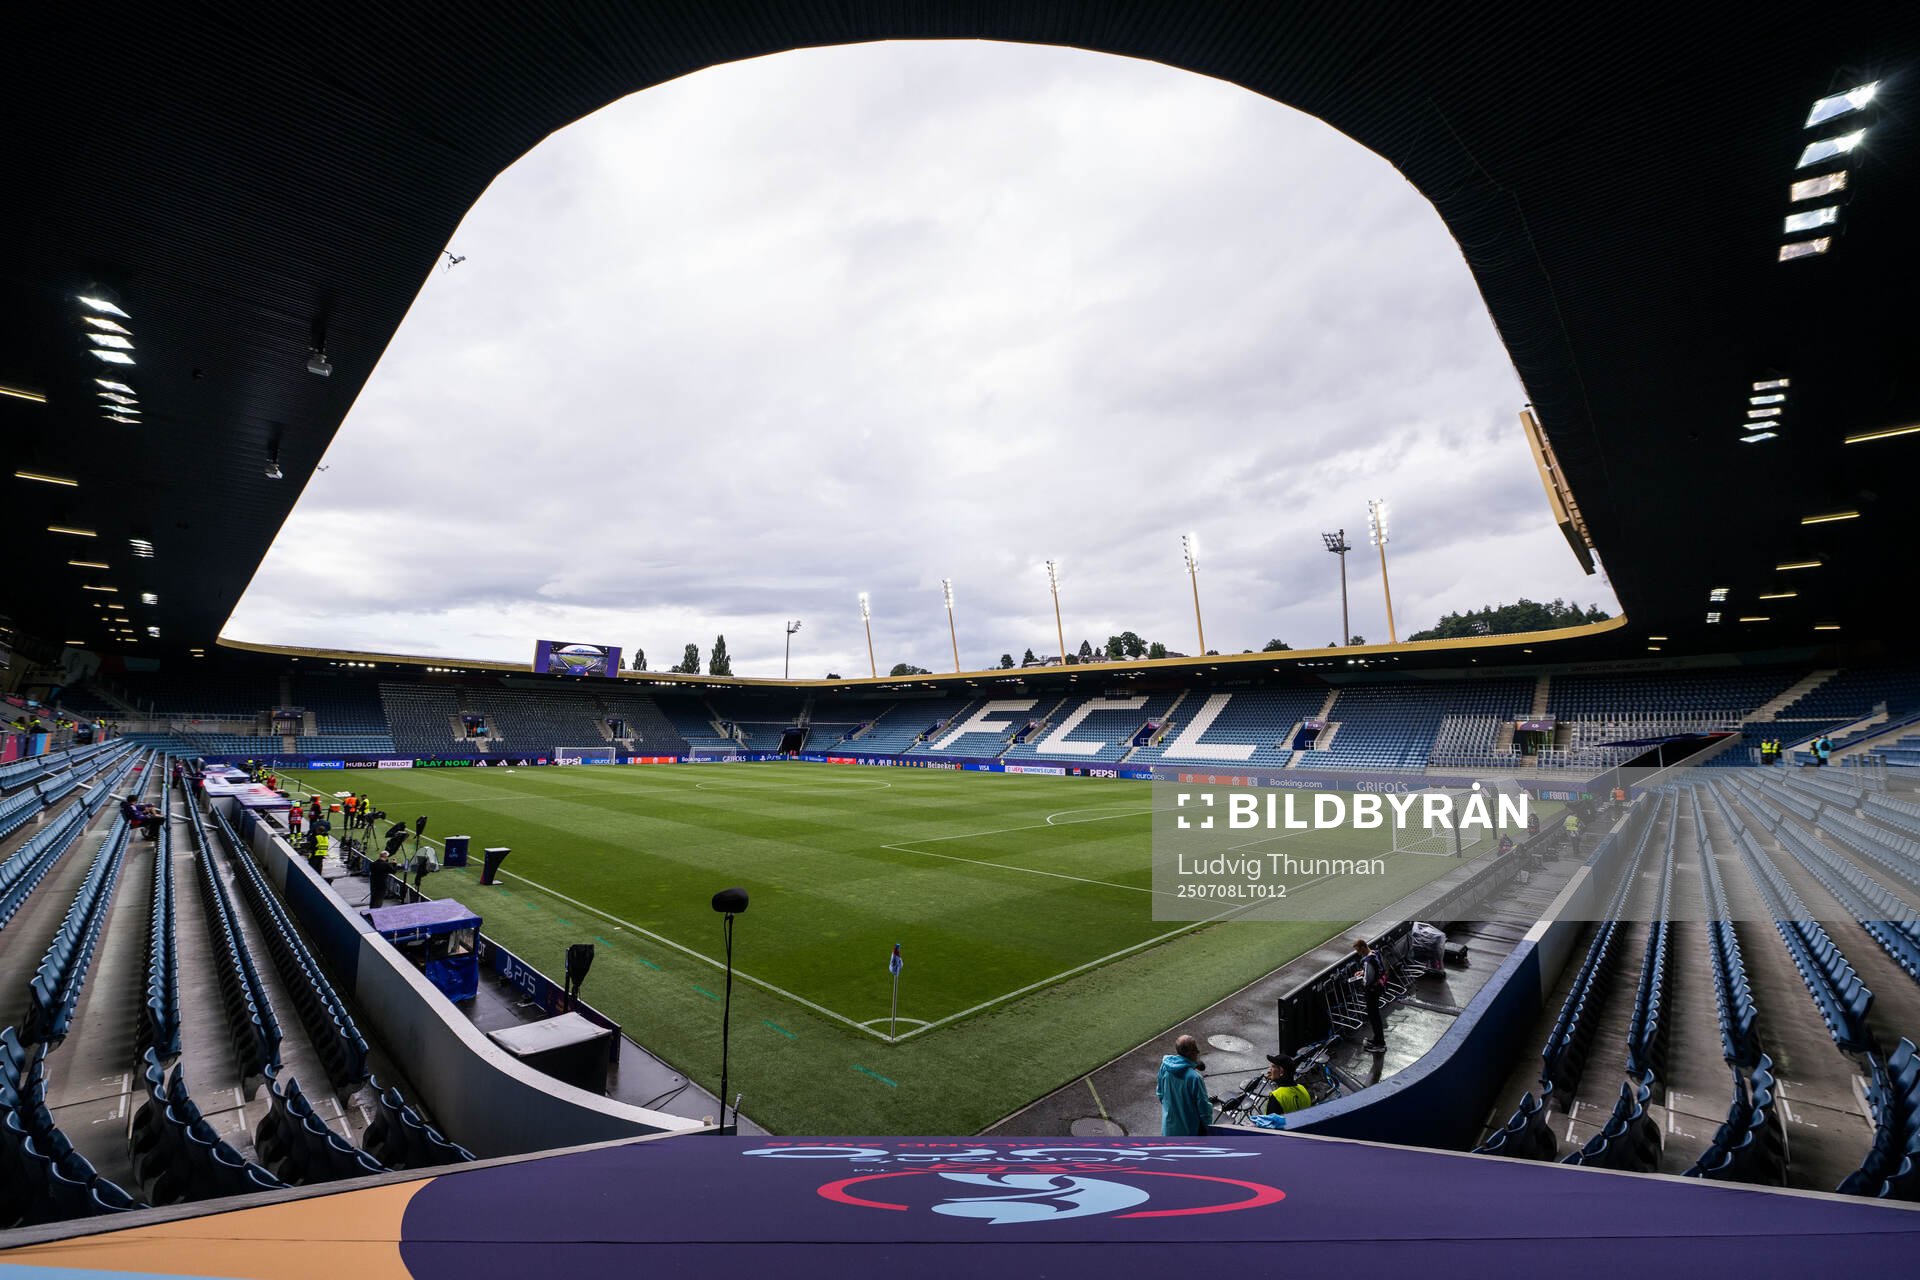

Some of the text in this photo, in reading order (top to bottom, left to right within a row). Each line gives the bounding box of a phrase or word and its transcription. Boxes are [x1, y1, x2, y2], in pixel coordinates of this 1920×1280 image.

[930, 693, 1257, 760] FCL
[415, 759, 470, 767] PLAY NOW
[927, 760, 956, 770] Heineken
[1090, 769, 1117, 778] PEPSI
[1270, 778, 1322, 788] Booking.com
[1356, 781, 1409, 792] GRIFOLS
[513, 967, 537, 995] PS5
